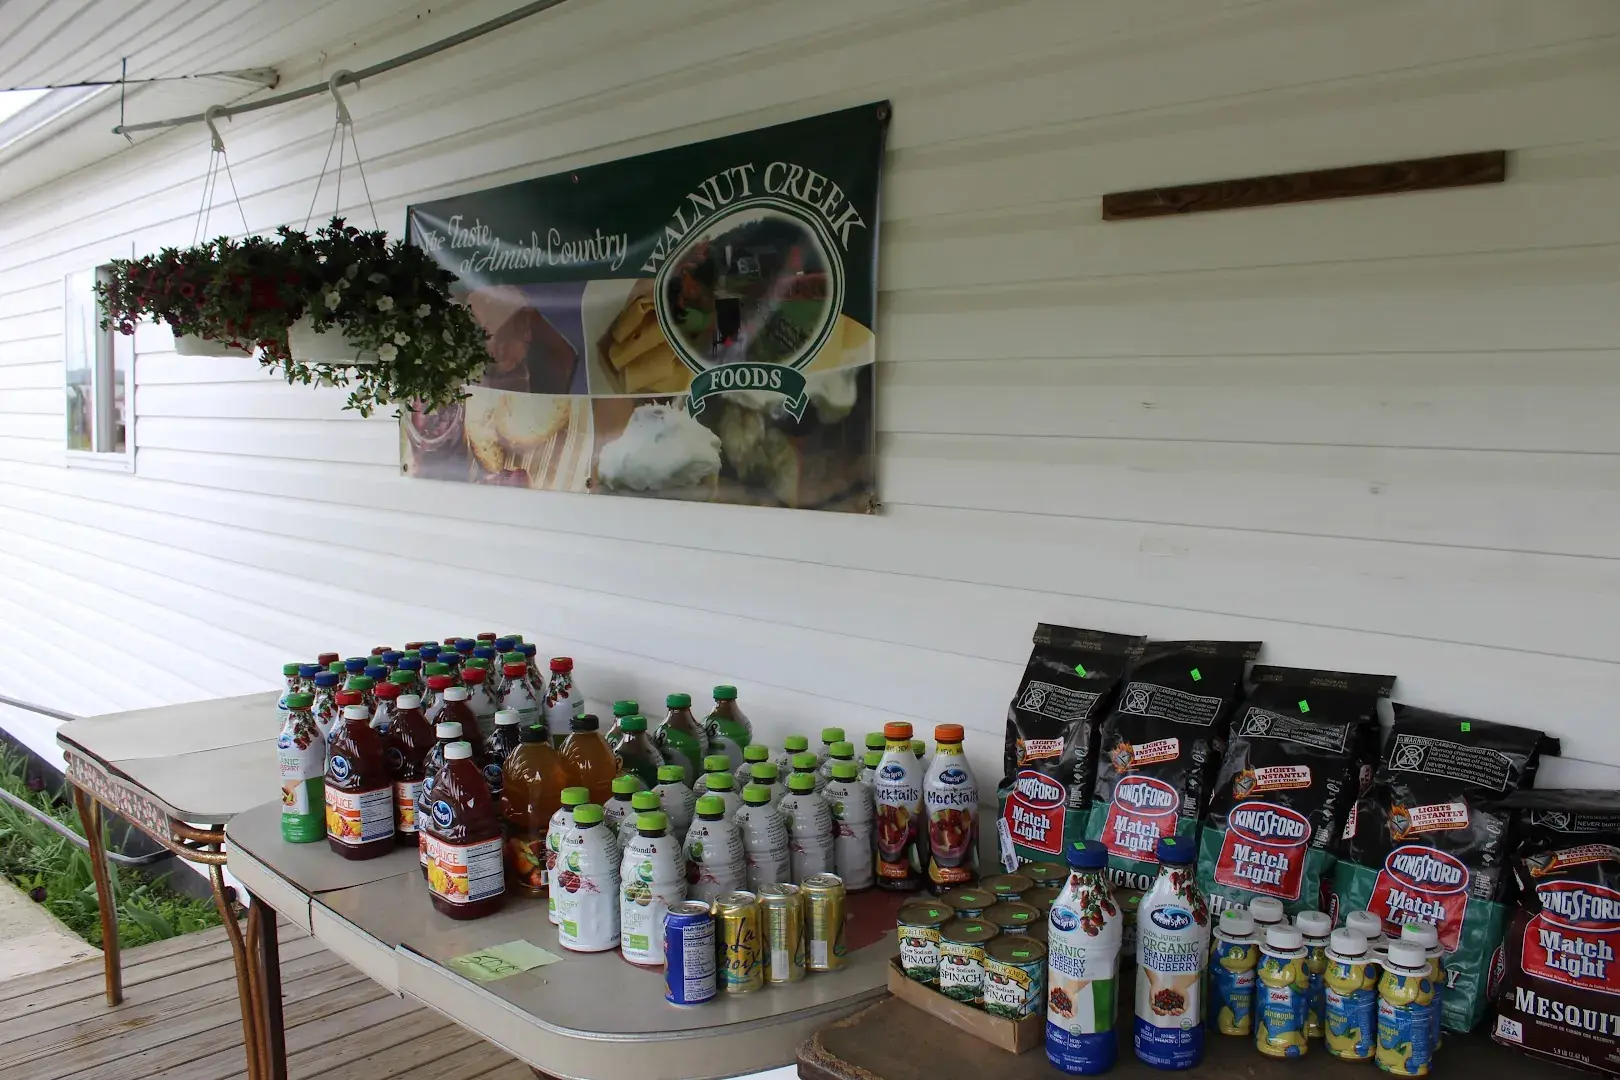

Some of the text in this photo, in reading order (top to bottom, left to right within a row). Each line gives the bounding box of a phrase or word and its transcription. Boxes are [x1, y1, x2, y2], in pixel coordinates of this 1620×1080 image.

[640, 161, 867, 275] WALNUT CREEK
[423, 213, 492, 255] The Taste
[460, 227, 628, 274] of Amish Country
[709, 367, 782, 390] FOODS
[1136, 744, 1176, 756] INSTANTLY
[1142, 740, 1167, 750] LIGHTS
[1404, 737, 1432, 745] WARNING
[1434, 741, 1457, 750] CARBON
[1458, 745, 1486, 755] MONOXIDE
[280, 757, 299, 766] ANIC
[280, 763, 300, 772] BERRY
[952, 774, 966, 784] Spray
[1257, 772, 1307, 780] INSTANTLY
[875, 787, 919, 804] ocktails
[927, 789, 979, 806] Mocktails
[1118, 782, 1173, 807] KINGSFORD
[1012, 804, 1050, 829] Match
[1413, 810, 1464, 821] INSTANTLY
[1418, 805, 1451, 813] LIGHTS
[1013, 820, 1046, 841] Light
[1113, 814, 1160, 838] Match
[1234, 810, 1305, 837] KINGSFORD
[1114, 829, 1154, 852] Light
[1231, 843, 1289, 871] Match
[1233, 860, 1282, 885] Light
[1392, 853, 1462, 884] KINGSFORD
[1104, 867, 1158, 891] ICKO
[1385, 888, 1445, 920] Match
[1060, 919, 1075, 930] Spray
[1153, 911, 1189, 928] Ocean Spray
[1142, 936, 1199, 954] ORGANIC
[1160, 934, 1181, 942] JUICE
[1538, 928, 1614, 962] Match
[901, 951, 939, 965] SPINACH
[914, 947, 933, 955] Sodium
[1049, 950, 1086, 968] ANBERRY
[1143, 947, 1198, 962] CRANBERRY
[945, 964, 955, 972] Low
[1049, 960, 1086, 978] UEBERRY
[1144, 955, 1198, 972] BLUEBERRY
[1545, 947, 1606, 979] Light
[941, 969, 981, 983] SPINACH
[994, 984, 1015, 994] Sodium
[1270, 992, 1289, 1001] Libby's
[1264, 1009, 1295, 1021] pineapple
[1515, 986, 1620, 1037] MESQUIT
[1269, 1018, 1286, 1027] juice
[1501, 1025, 1518, 1037] USA
